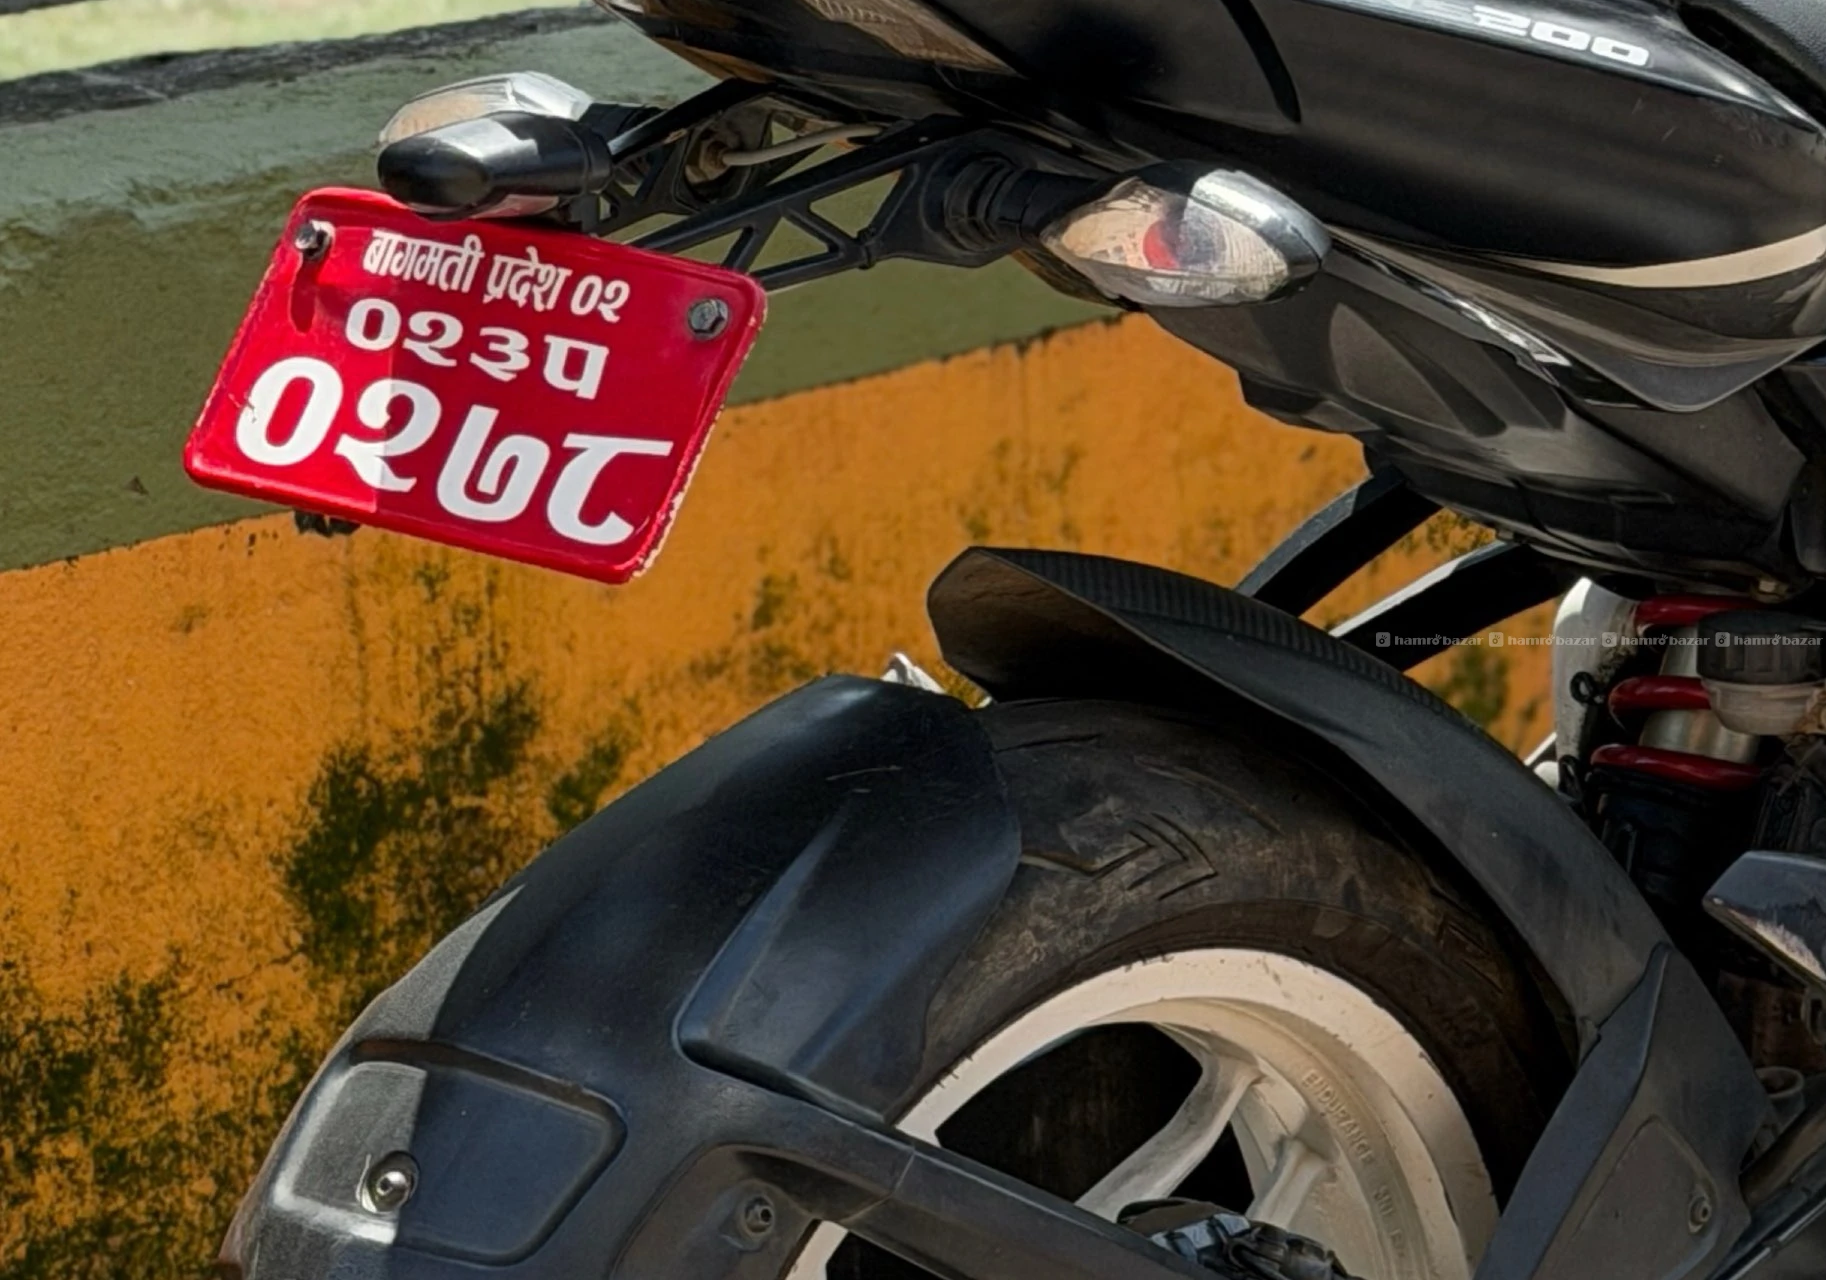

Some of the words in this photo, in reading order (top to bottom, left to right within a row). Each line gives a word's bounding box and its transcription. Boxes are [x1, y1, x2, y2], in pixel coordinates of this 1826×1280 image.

[362, 228, 485, 293] बागमती
[482, 246, 572, 312] प्रदेश
[570, 275, 630, 323] ०२
[234, 356, 674, 546] ०२७८
